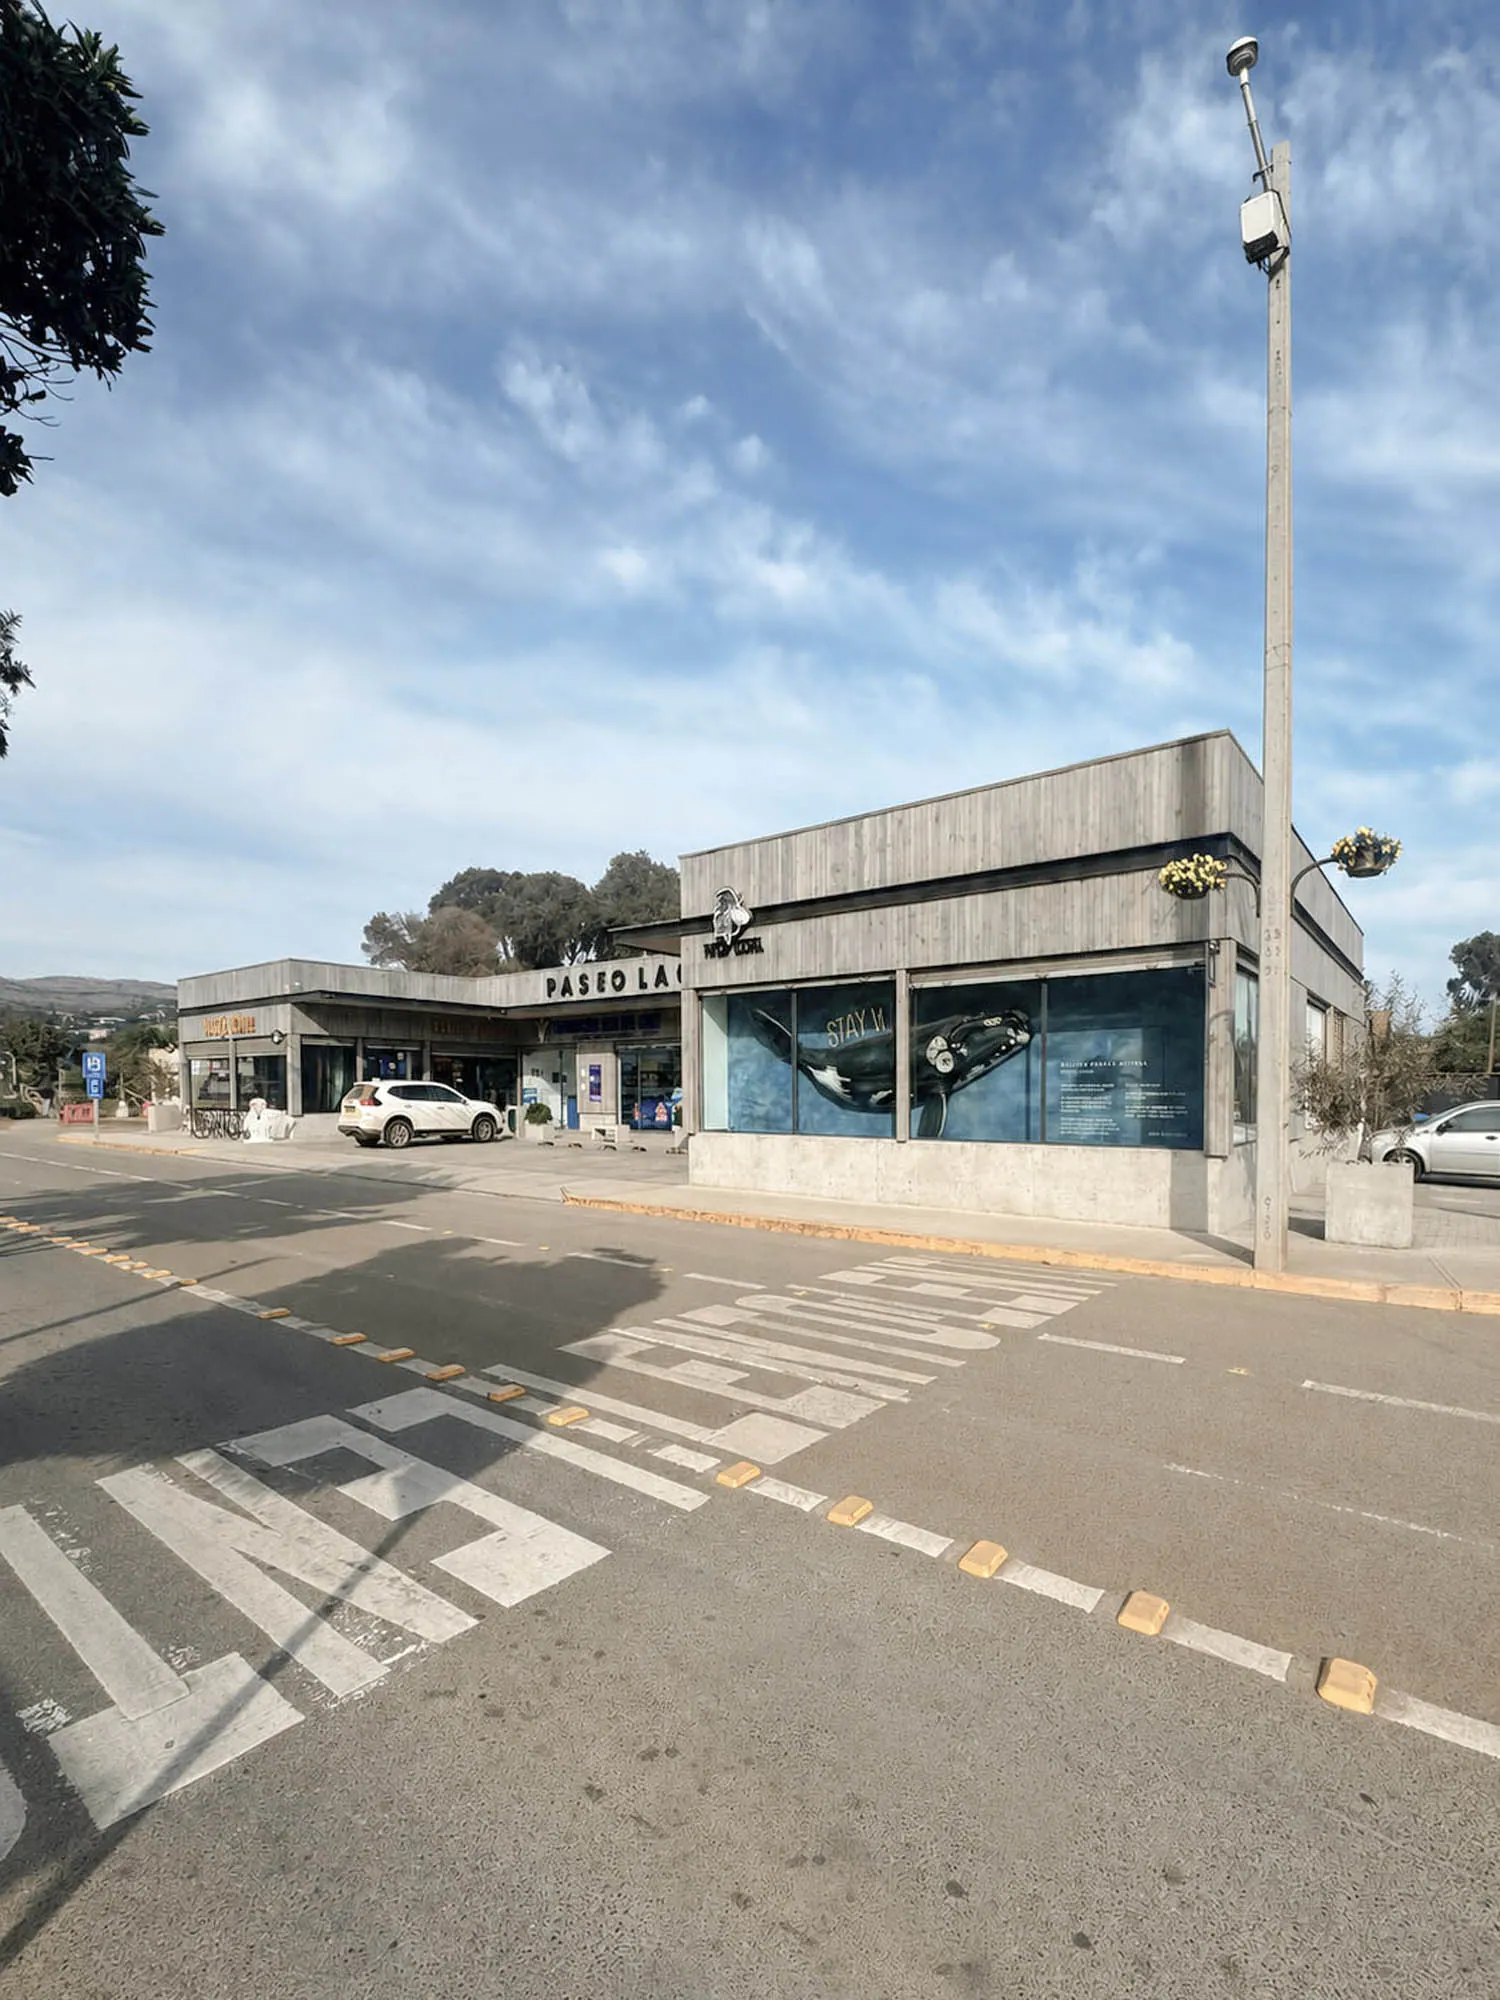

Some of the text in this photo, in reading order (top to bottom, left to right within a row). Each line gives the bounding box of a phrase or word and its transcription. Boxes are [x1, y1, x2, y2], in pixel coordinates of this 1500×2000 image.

[547, 969, 626, 998] PASEO
[827, 1008, 866, 1048] STAY
[0, 1386, 712, 1862] LENT
